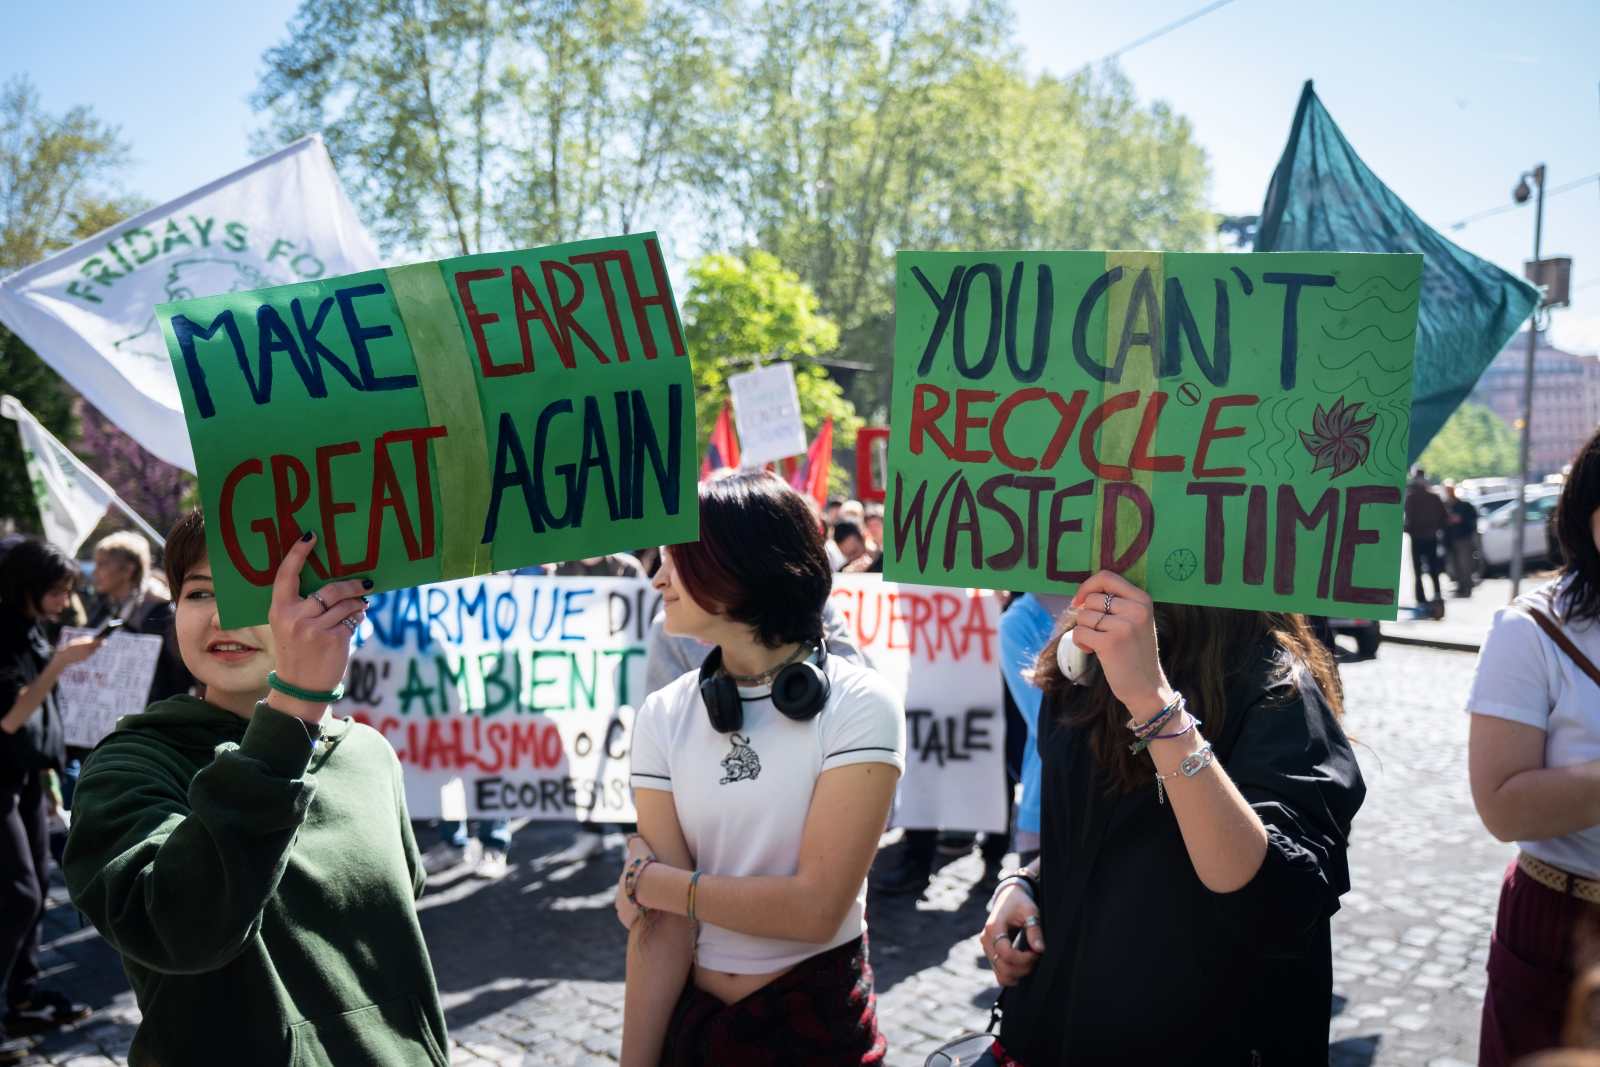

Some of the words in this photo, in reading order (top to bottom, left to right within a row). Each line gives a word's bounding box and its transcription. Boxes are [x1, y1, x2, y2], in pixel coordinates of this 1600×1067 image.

[66, 214, 248, 303] FRIDAYS
[266, 238, 326, 279] FO
[171, 283, 418, 418] MAKE
[454, 238, 686, 378] EARTH
[910, 261, 1054, 383] YOU
[1072, 266, 1336, 391] CAN'T
[219, 425, 448, 587] GREAT
[481, 384, 683, 544] AGAIN
[909, 382, 1259, 481] RECYCLE
[893, 468, 1155, 582] WASTED
[1186, 481, 1401, 605] TIME
[352, 712, 563, 774] CIALISMO
